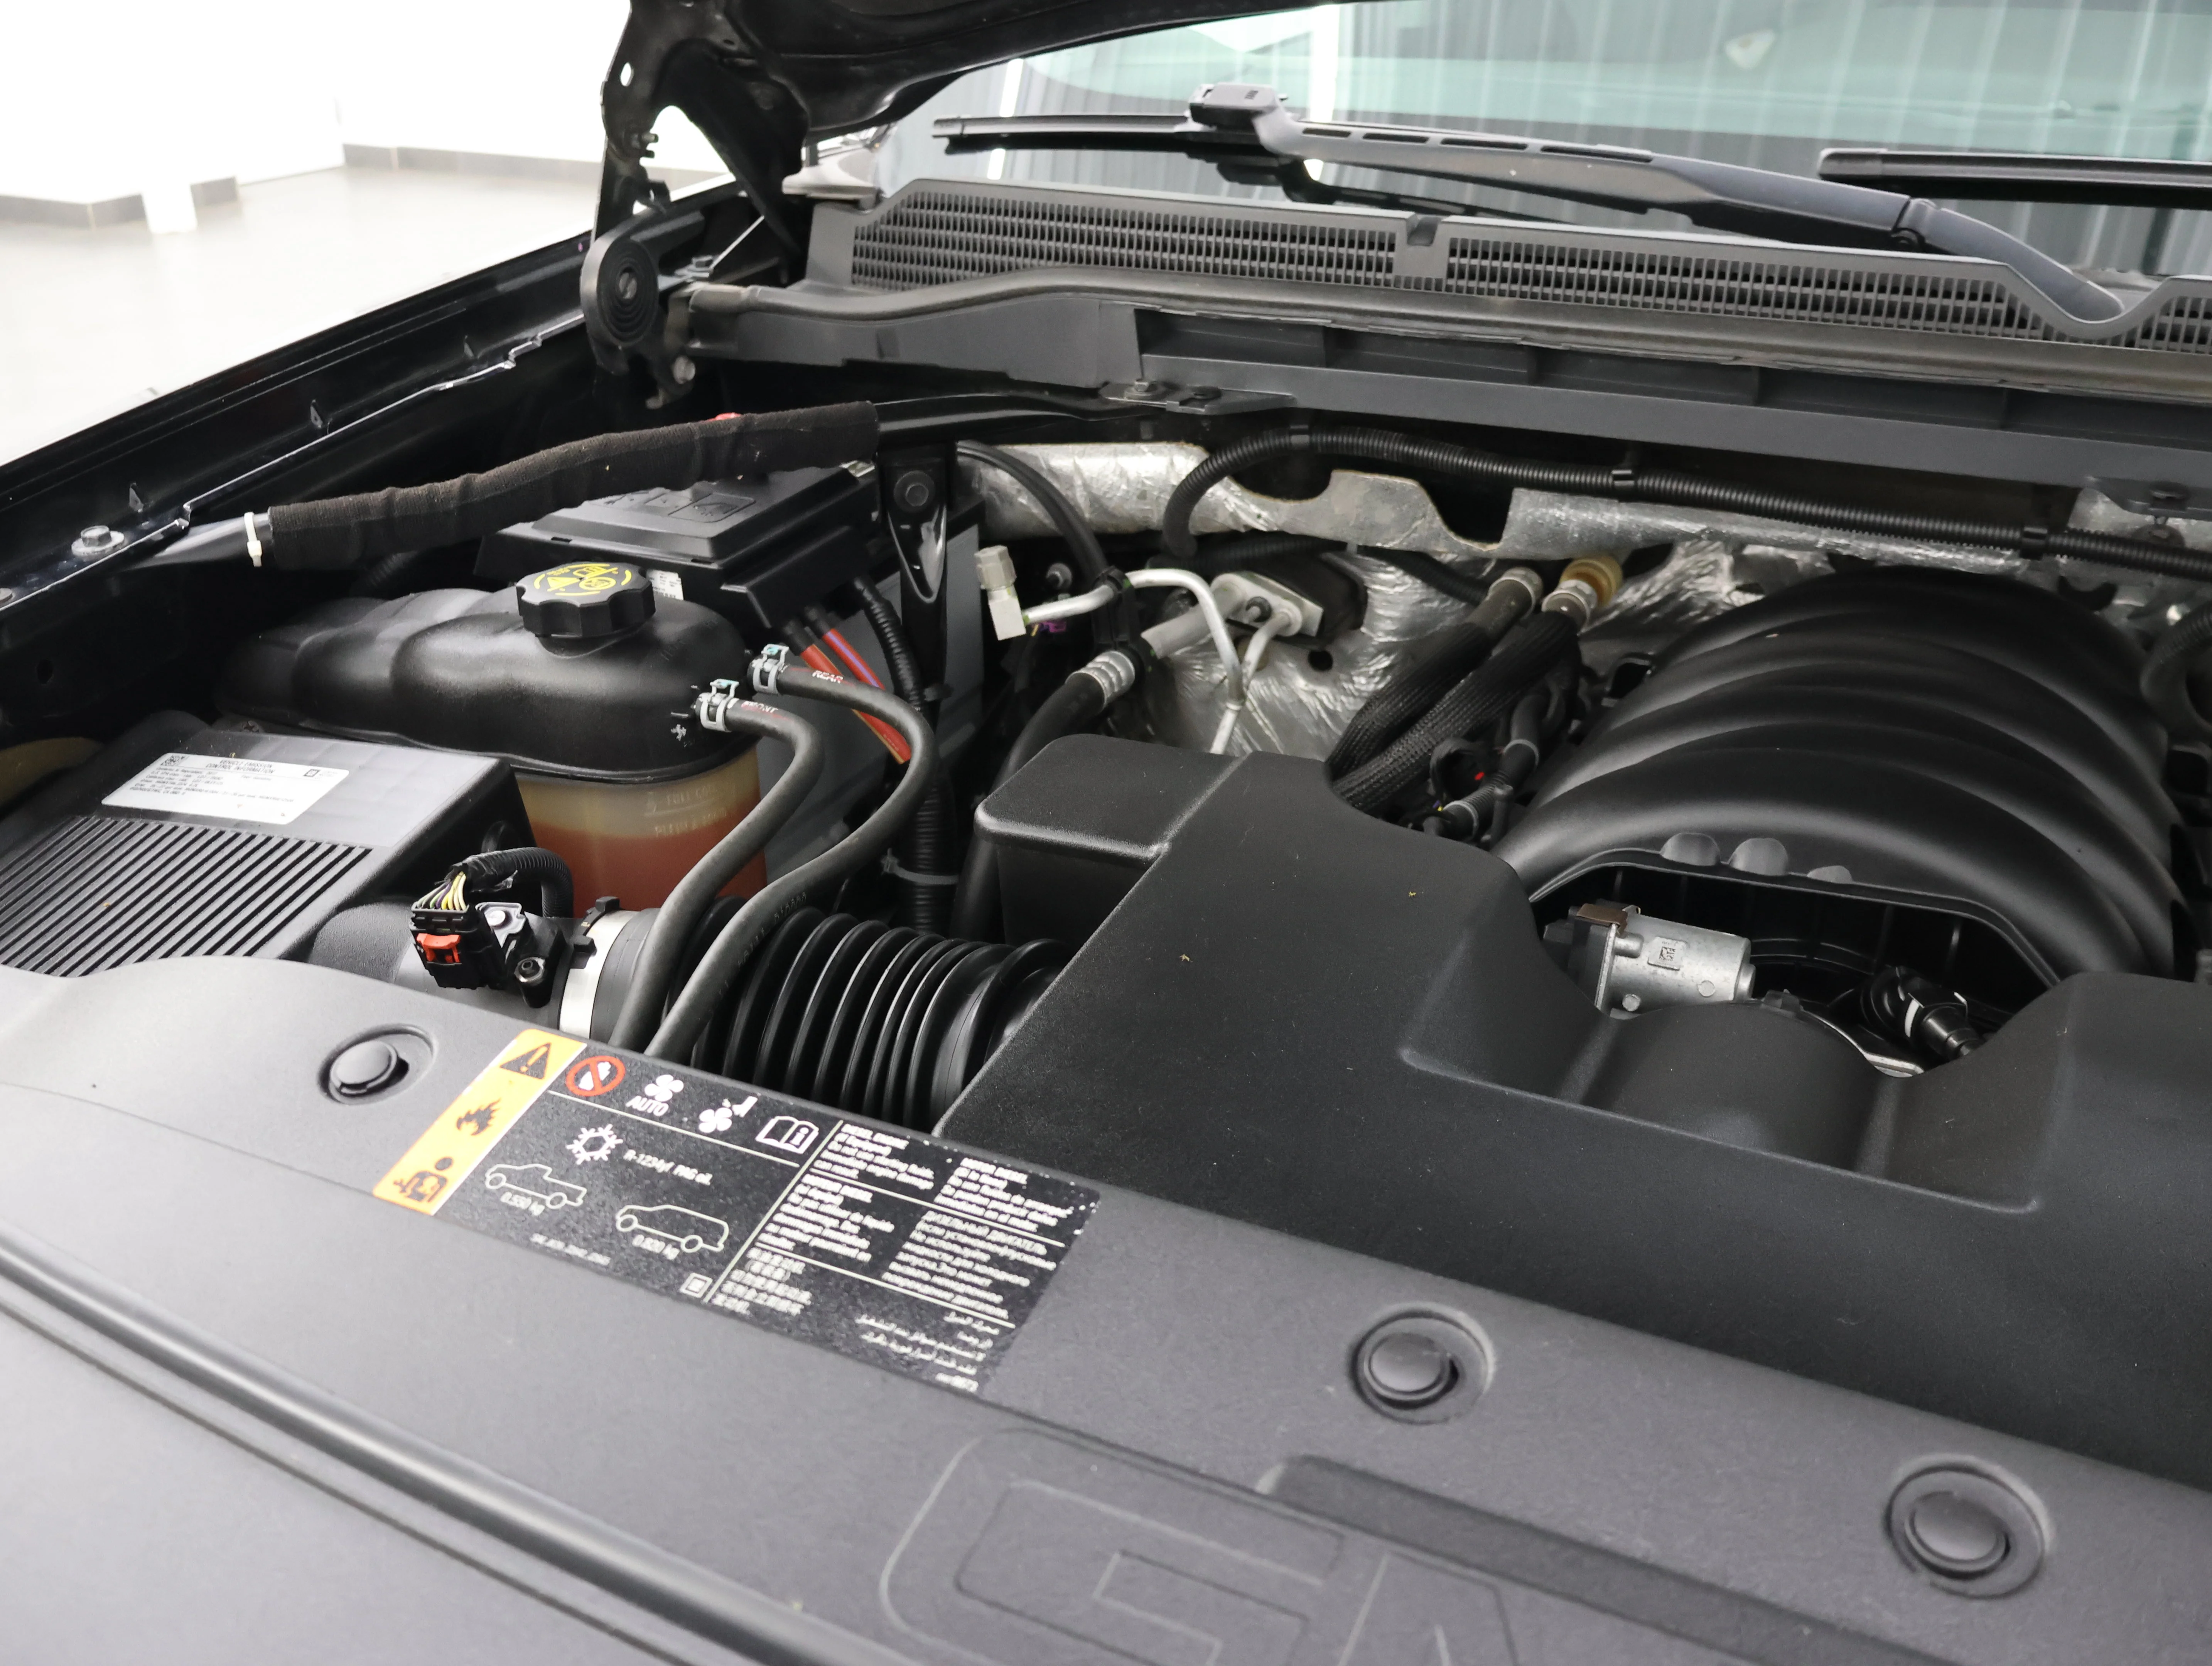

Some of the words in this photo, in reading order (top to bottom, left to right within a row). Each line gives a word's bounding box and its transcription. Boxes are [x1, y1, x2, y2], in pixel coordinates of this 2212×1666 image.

[812, 670, 844, 684] REAR
[741, 701, 778, 713] FRONT
[625, 1095, 669, 1116] AUTO
[623, 1148, 675, 1173] R-1234yf
